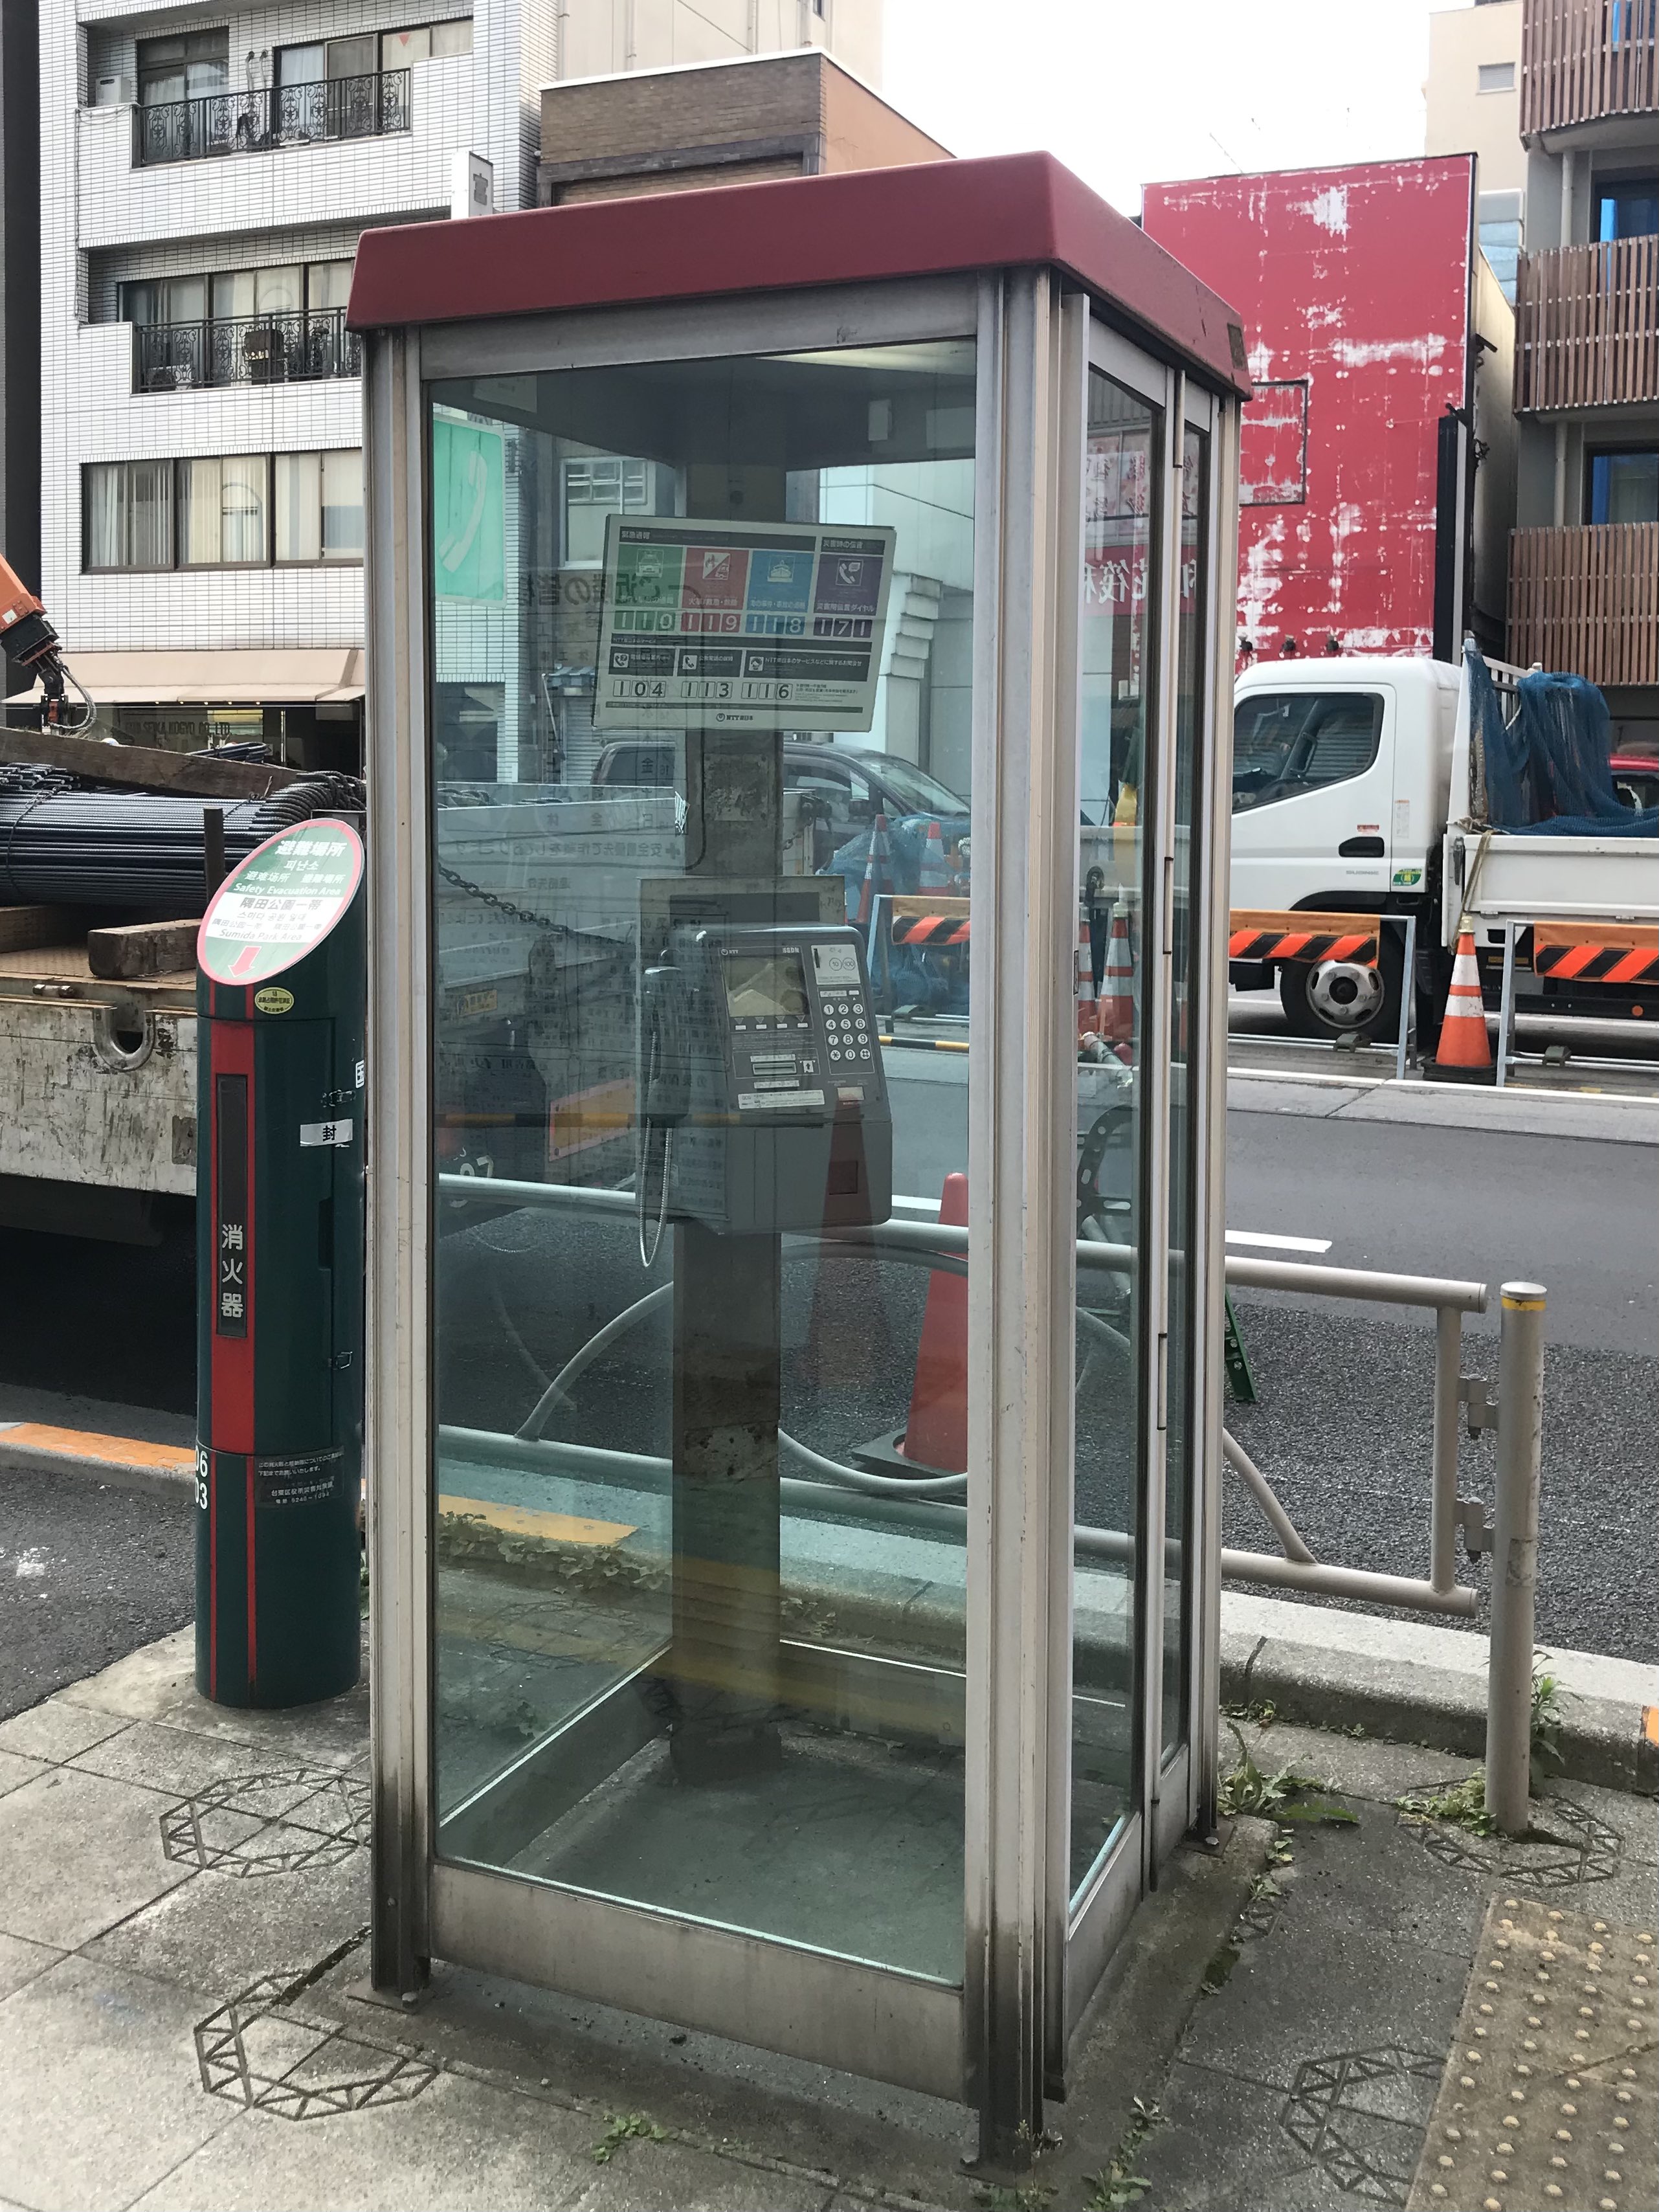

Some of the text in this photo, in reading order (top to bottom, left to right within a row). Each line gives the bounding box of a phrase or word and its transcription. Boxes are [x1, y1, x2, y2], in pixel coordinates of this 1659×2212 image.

[621, 612, 673, 630] 110
[688, 614, 737, 631] 119
[753, 616, 801, 633] 118
[821, 619, 866, 636] 171
[619, 681, 663, 697] 104
[687, 682, 729, 697] 113
[748, 684, 789, 698] 116
[274, 840, 348, 857] 避難場所
[284, 860, 319, 871] 피난소
[234, 883, 341, 895] Safety Evacuation Area
[239, 897, 323, 911] 隅田公園一帯
[237, 911, 265, 920] 스미다
[219, 929, 255, 939] Sumida
[322, 1124, 337, 1141] 封
[221, 1223, 243, 1318] 消火器
